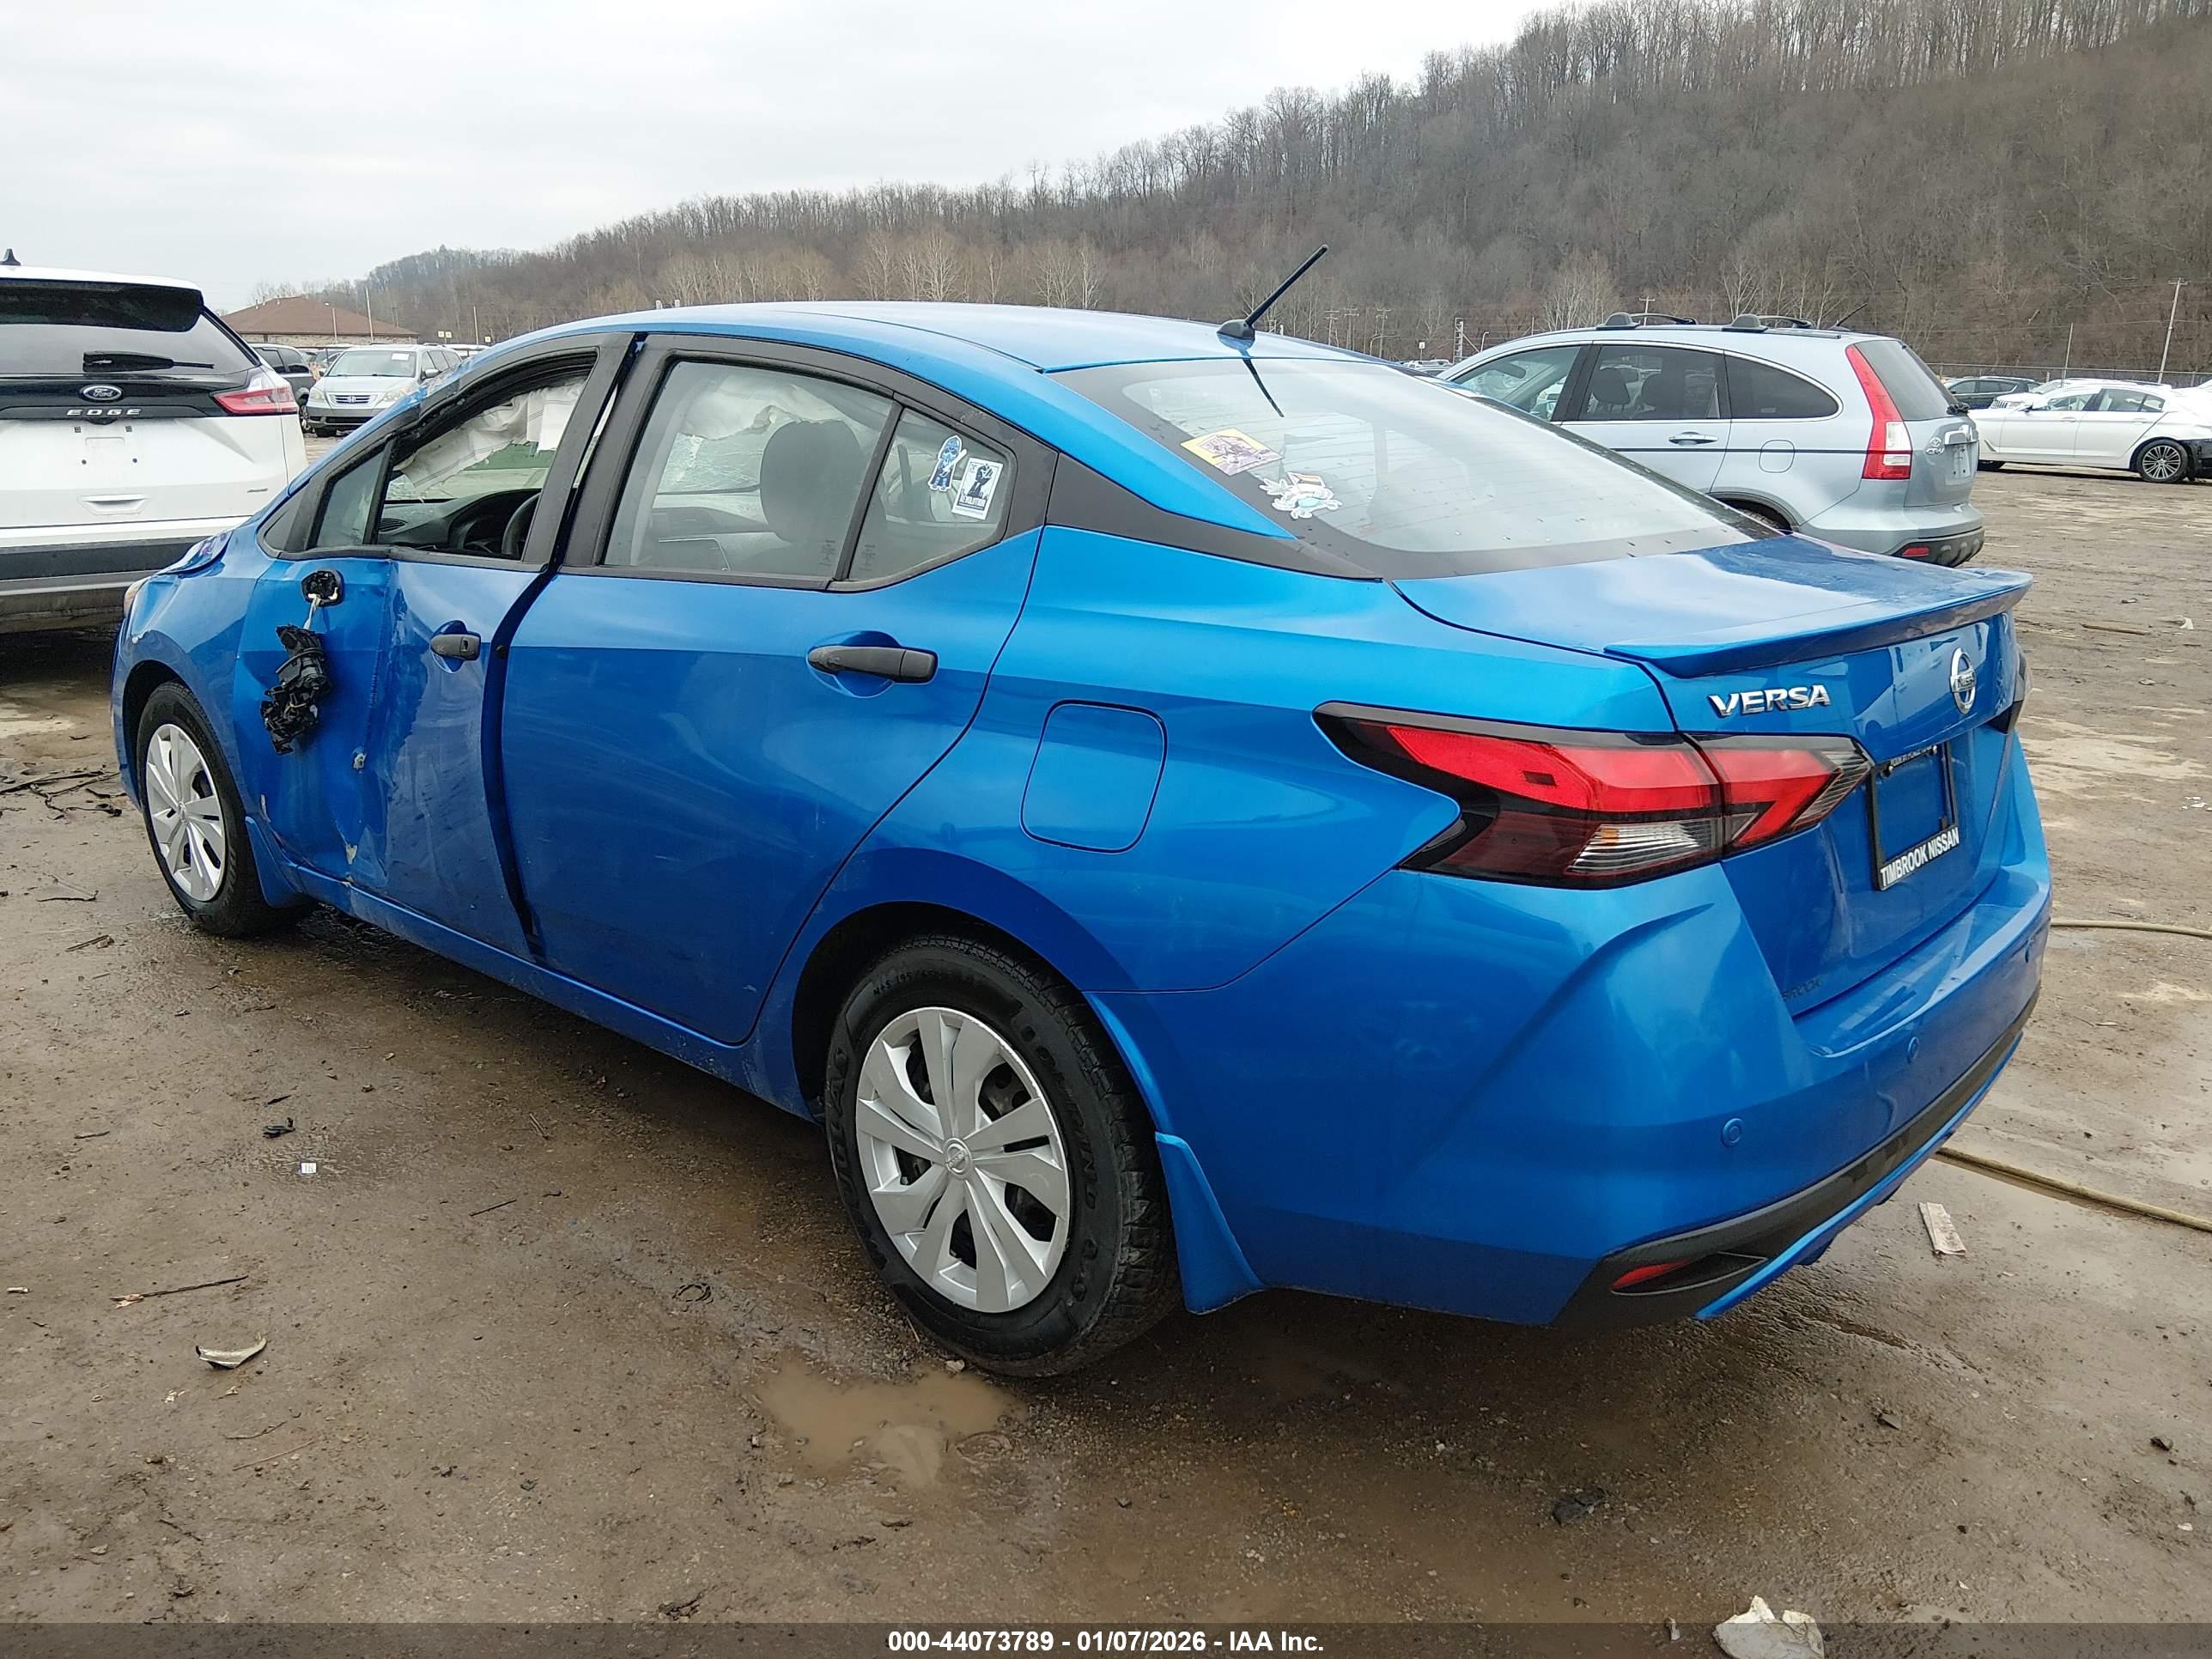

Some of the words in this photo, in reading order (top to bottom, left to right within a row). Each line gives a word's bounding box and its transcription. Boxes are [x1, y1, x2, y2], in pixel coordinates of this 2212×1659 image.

[92, 388, 113, 398] Ford
[1708, 684, 1831, 717] VERSA
[1880, 844, 1929, 887] TIMBROOK
[1928, 826, 1960, 860] NISSAN
